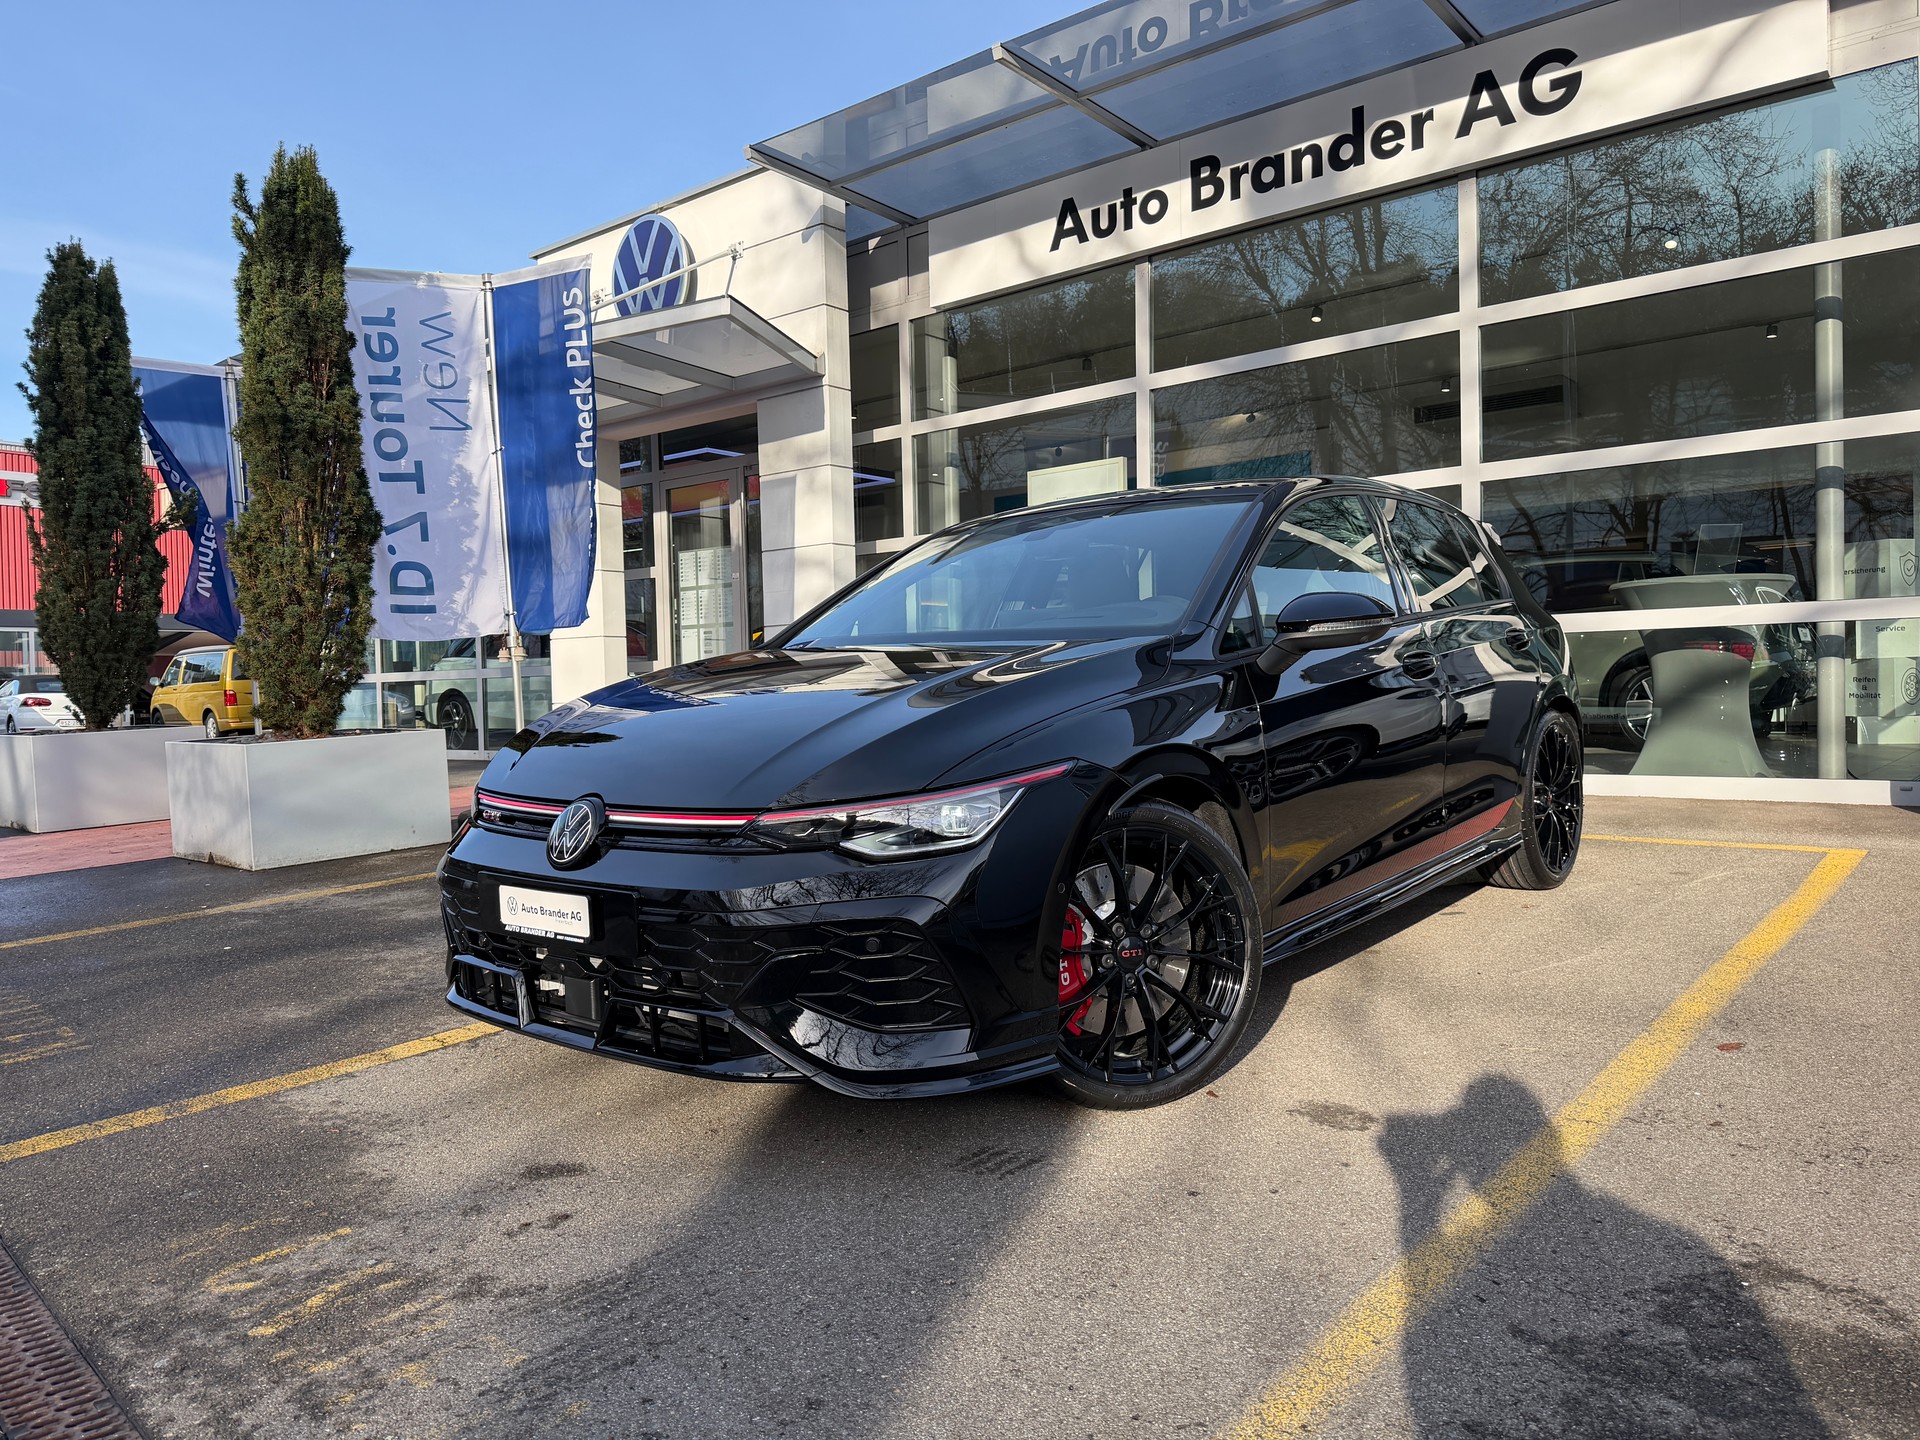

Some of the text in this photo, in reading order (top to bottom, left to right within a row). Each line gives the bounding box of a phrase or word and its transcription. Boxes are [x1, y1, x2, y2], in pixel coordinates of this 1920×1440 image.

[1049, 47, 1583, 252] Auto Brander AG
[562, 286, 594, 468] Check PLUS
[1843, 565, 1886, 576] ersicherung
[1875, 625, 1906, 633] Service
[521, 903, 582, 921] Auto Brander AG
[504, 924, 520, 933] AUTO
[520, 926, 546, 937] BRANDER
[1121, 949, 1143, 958] GTI
